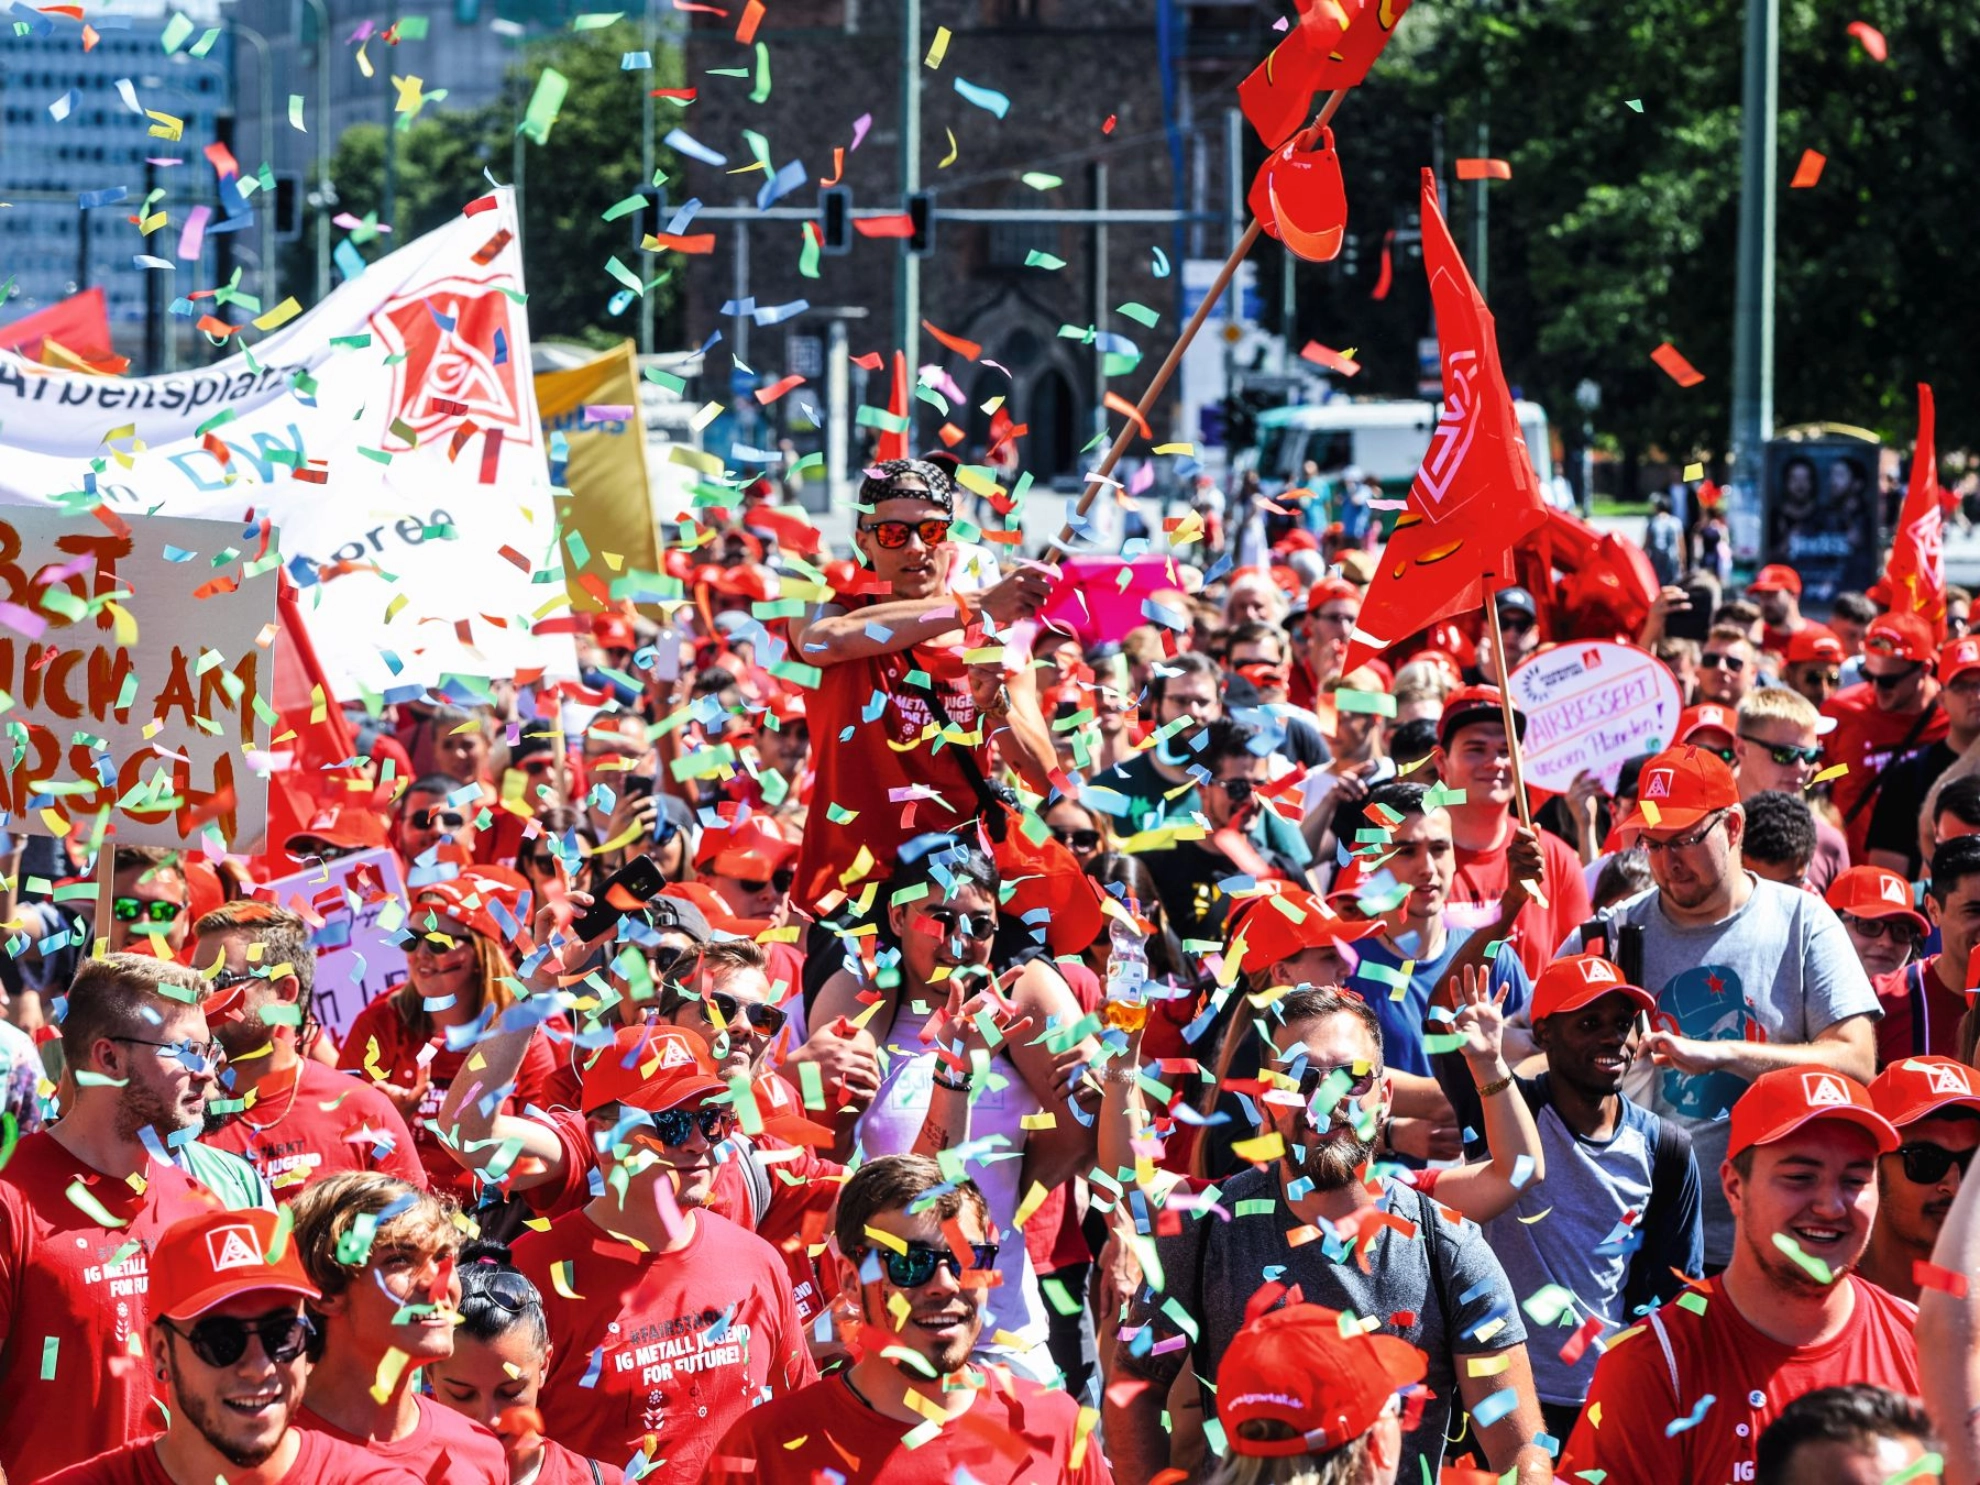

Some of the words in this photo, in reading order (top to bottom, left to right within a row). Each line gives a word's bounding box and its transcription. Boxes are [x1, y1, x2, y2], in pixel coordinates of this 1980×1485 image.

[0, 637, 140, 725] ICH
[153, 646, 257, 746] AM
[0, 724, 238, 850] RSCH
[84, 1267, 102, 1285] IG
[110, 1278, 134, 1298] FOR
[615, 1352, 634, 1373] IG
[635, 1336, 695, 1366] METALL
[643, 1362, 673, 1386] FOR
[674, 1345, 740, 1374] FUTURE!
[1733, 1460, 1755, 1482] IG
